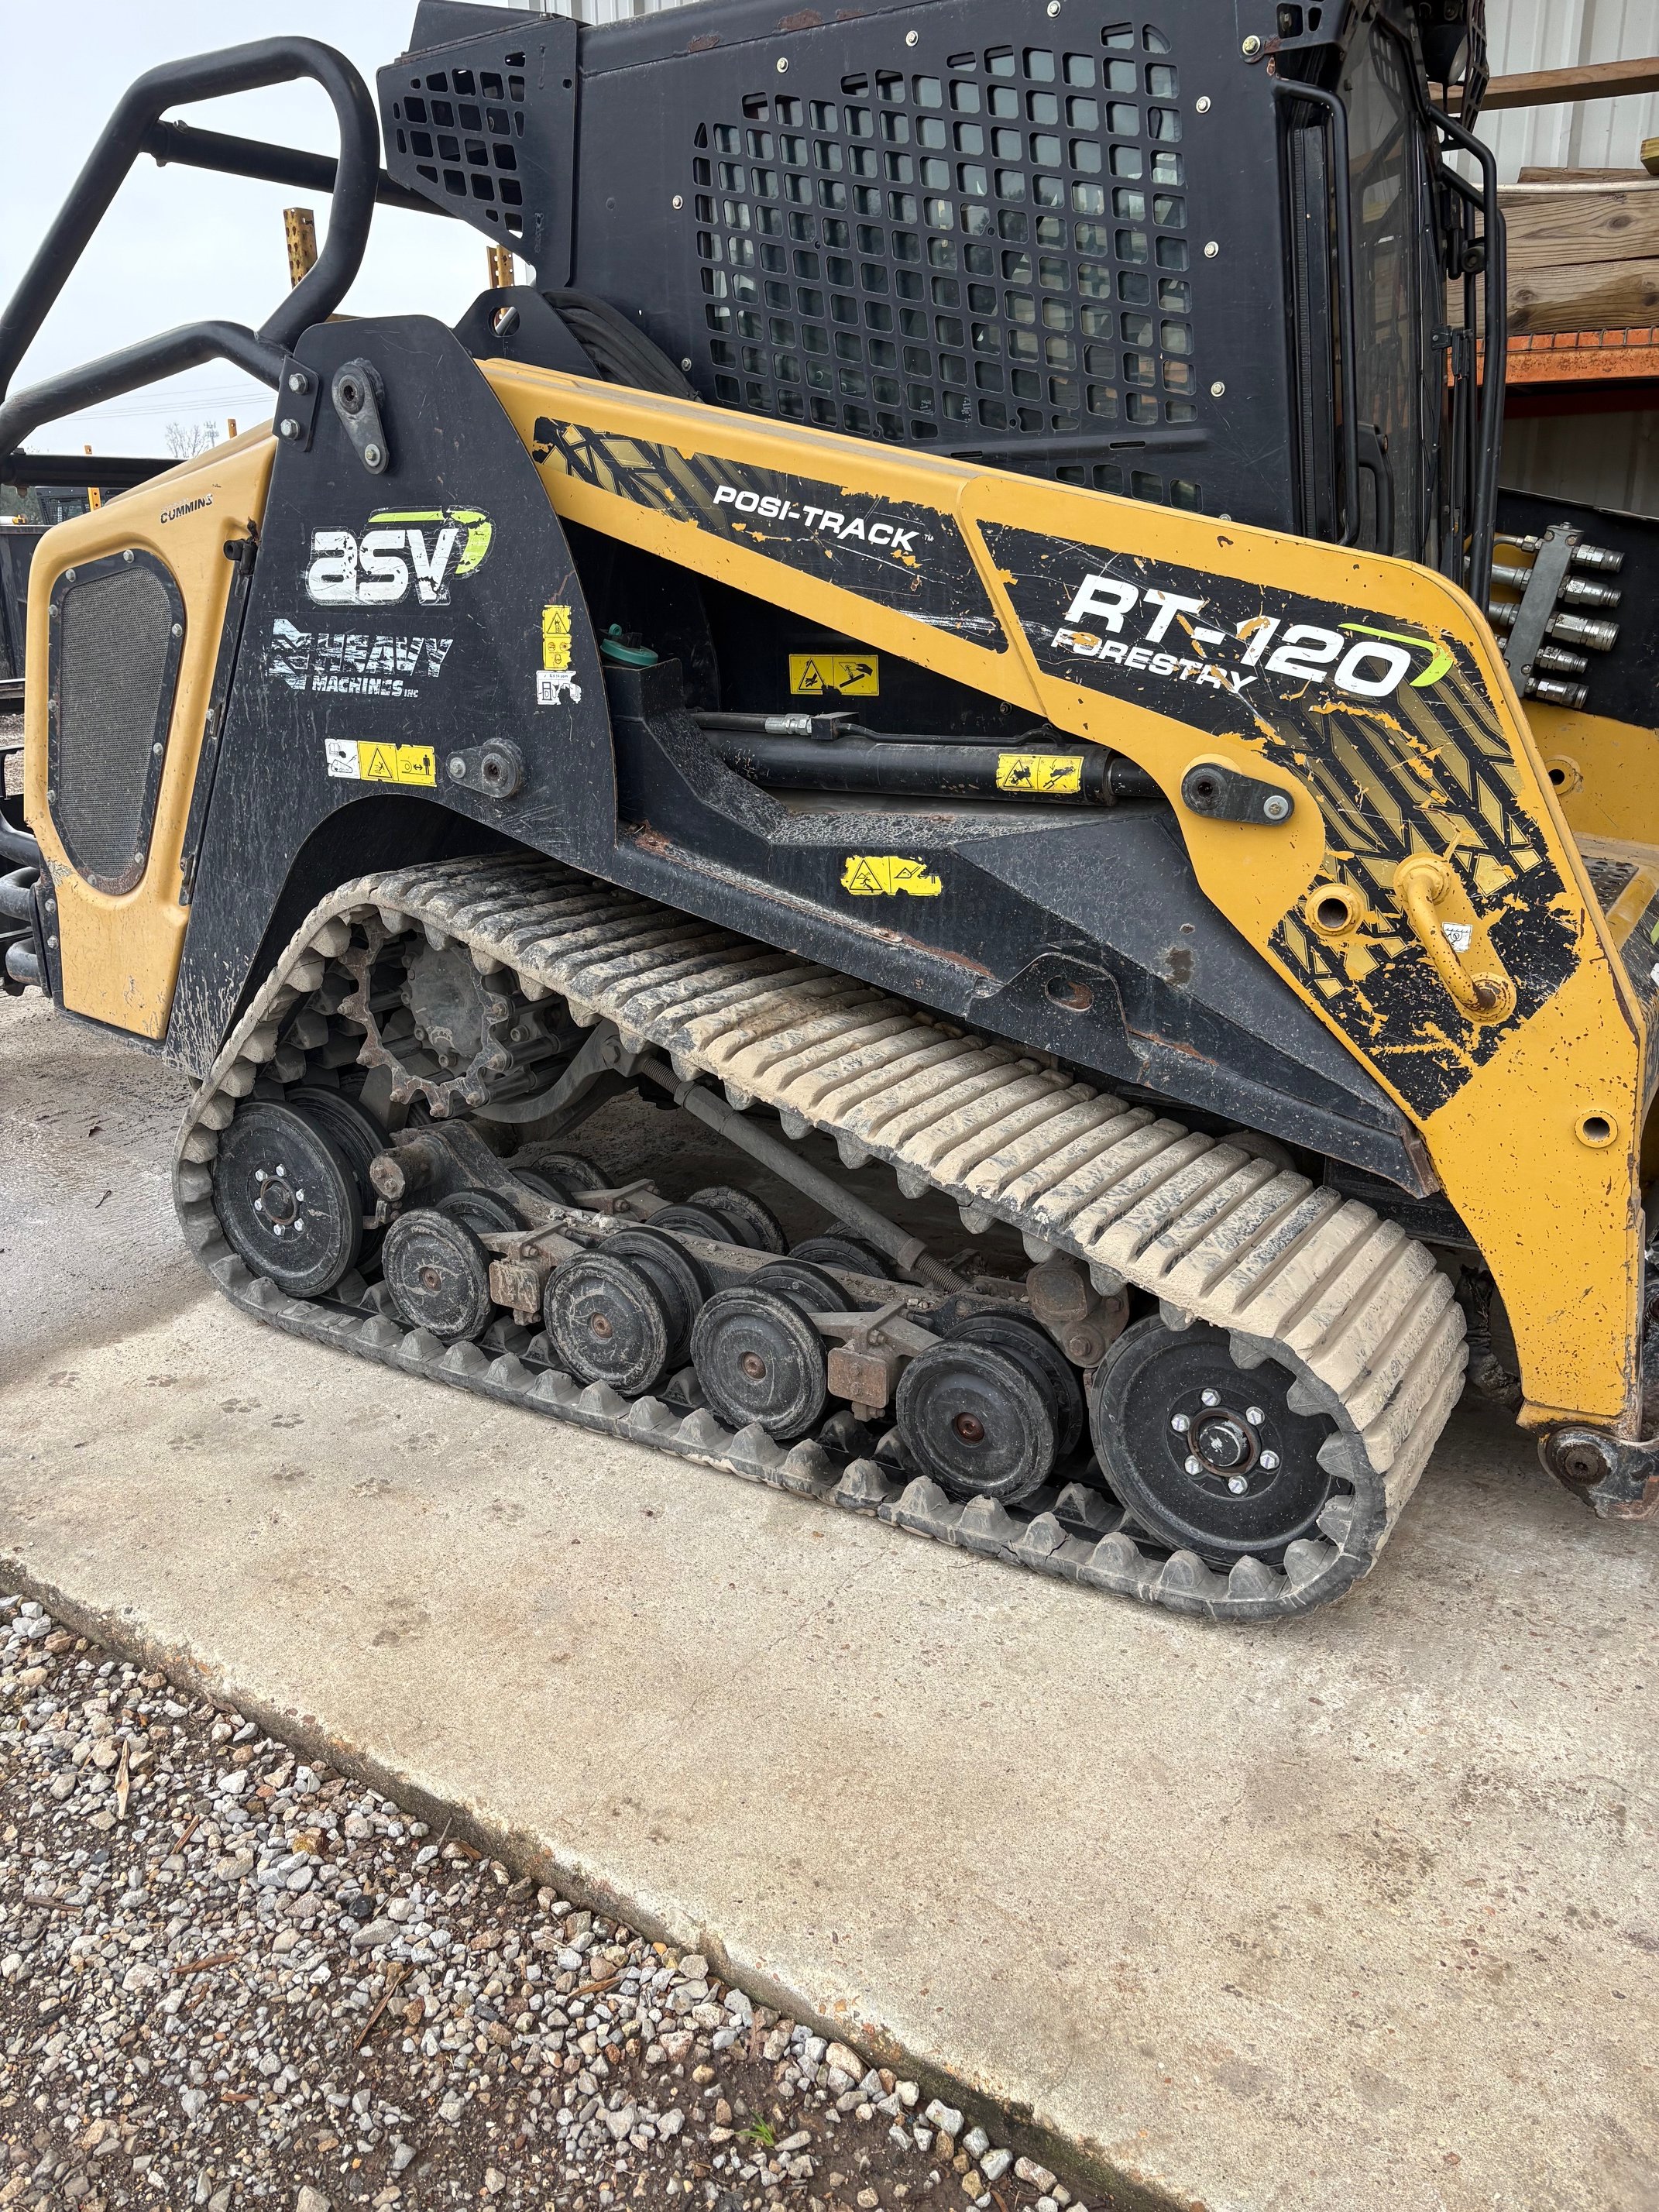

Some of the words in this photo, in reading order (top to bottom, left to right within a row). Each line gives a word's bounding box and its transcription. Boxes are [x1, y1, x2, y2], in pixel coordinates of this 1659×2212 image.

[160, 494, 213, 524] CUMMINS
[713, 485, 919, 551] POSI-TRACK
[313, 633, 454, 678] HEAVY
[1050, 627, 1258, 694] FORESTRY
[1064, 573, 1411, 697] RT-120
[311, 675, 404, 697] MACHINES
[404, 689, 419, 698] INC
